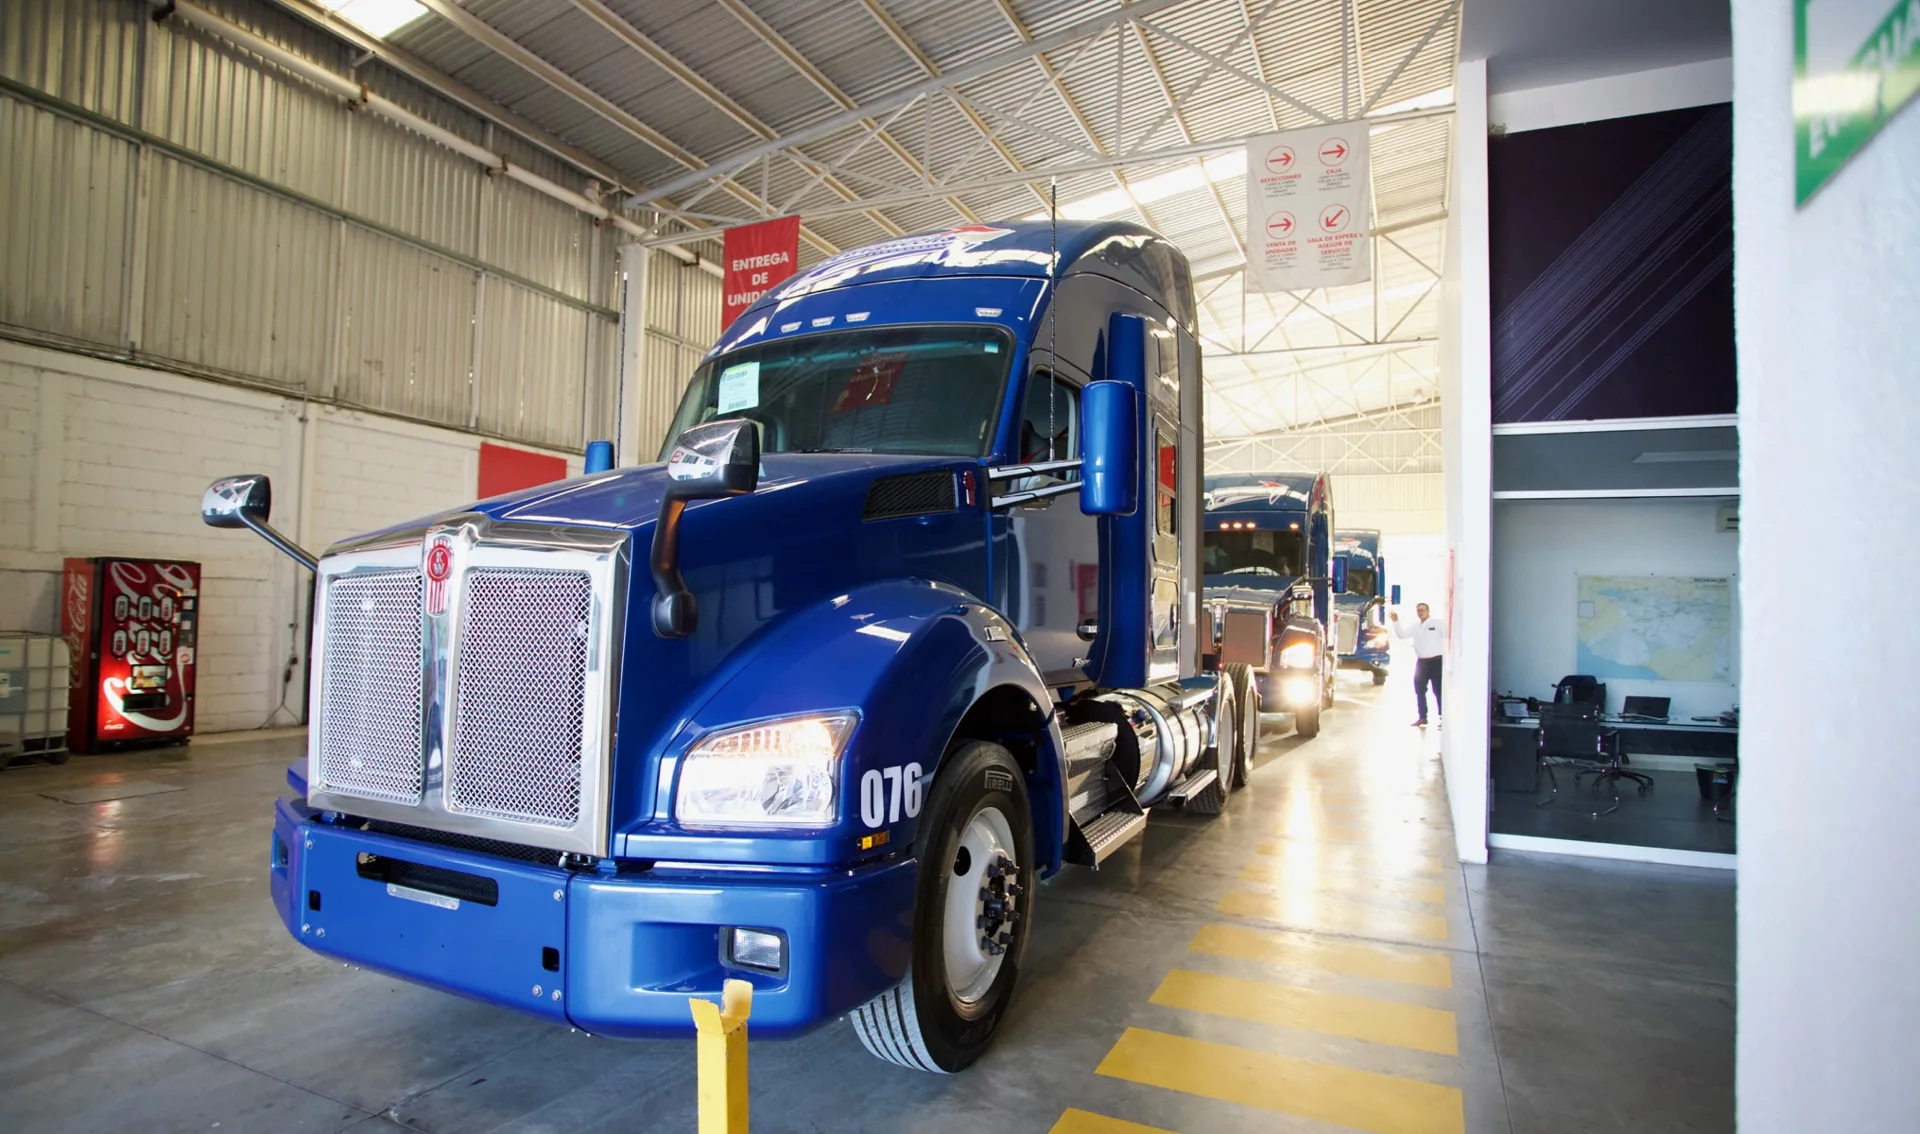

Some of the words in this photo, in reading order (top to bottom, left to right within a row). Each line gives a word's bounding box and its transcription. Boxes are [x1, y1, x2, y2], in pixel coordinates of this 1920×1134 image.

[1260, 174, 1302, 183] REFACCIONES
[1307, 235, 1323, 243] SALA
[1318, 241, 1342, 249] ASESOR
[1265, 246, 1298, 255] UNIDADES
[1320, 247, 1350, 255] SERVICIO
[732, 251, 789, 272] ENTREGA
[751, 272, 768, 286] DE
[984, 770, 1013, 792] PIRELLI
[861, 762, 923, 828] 076
